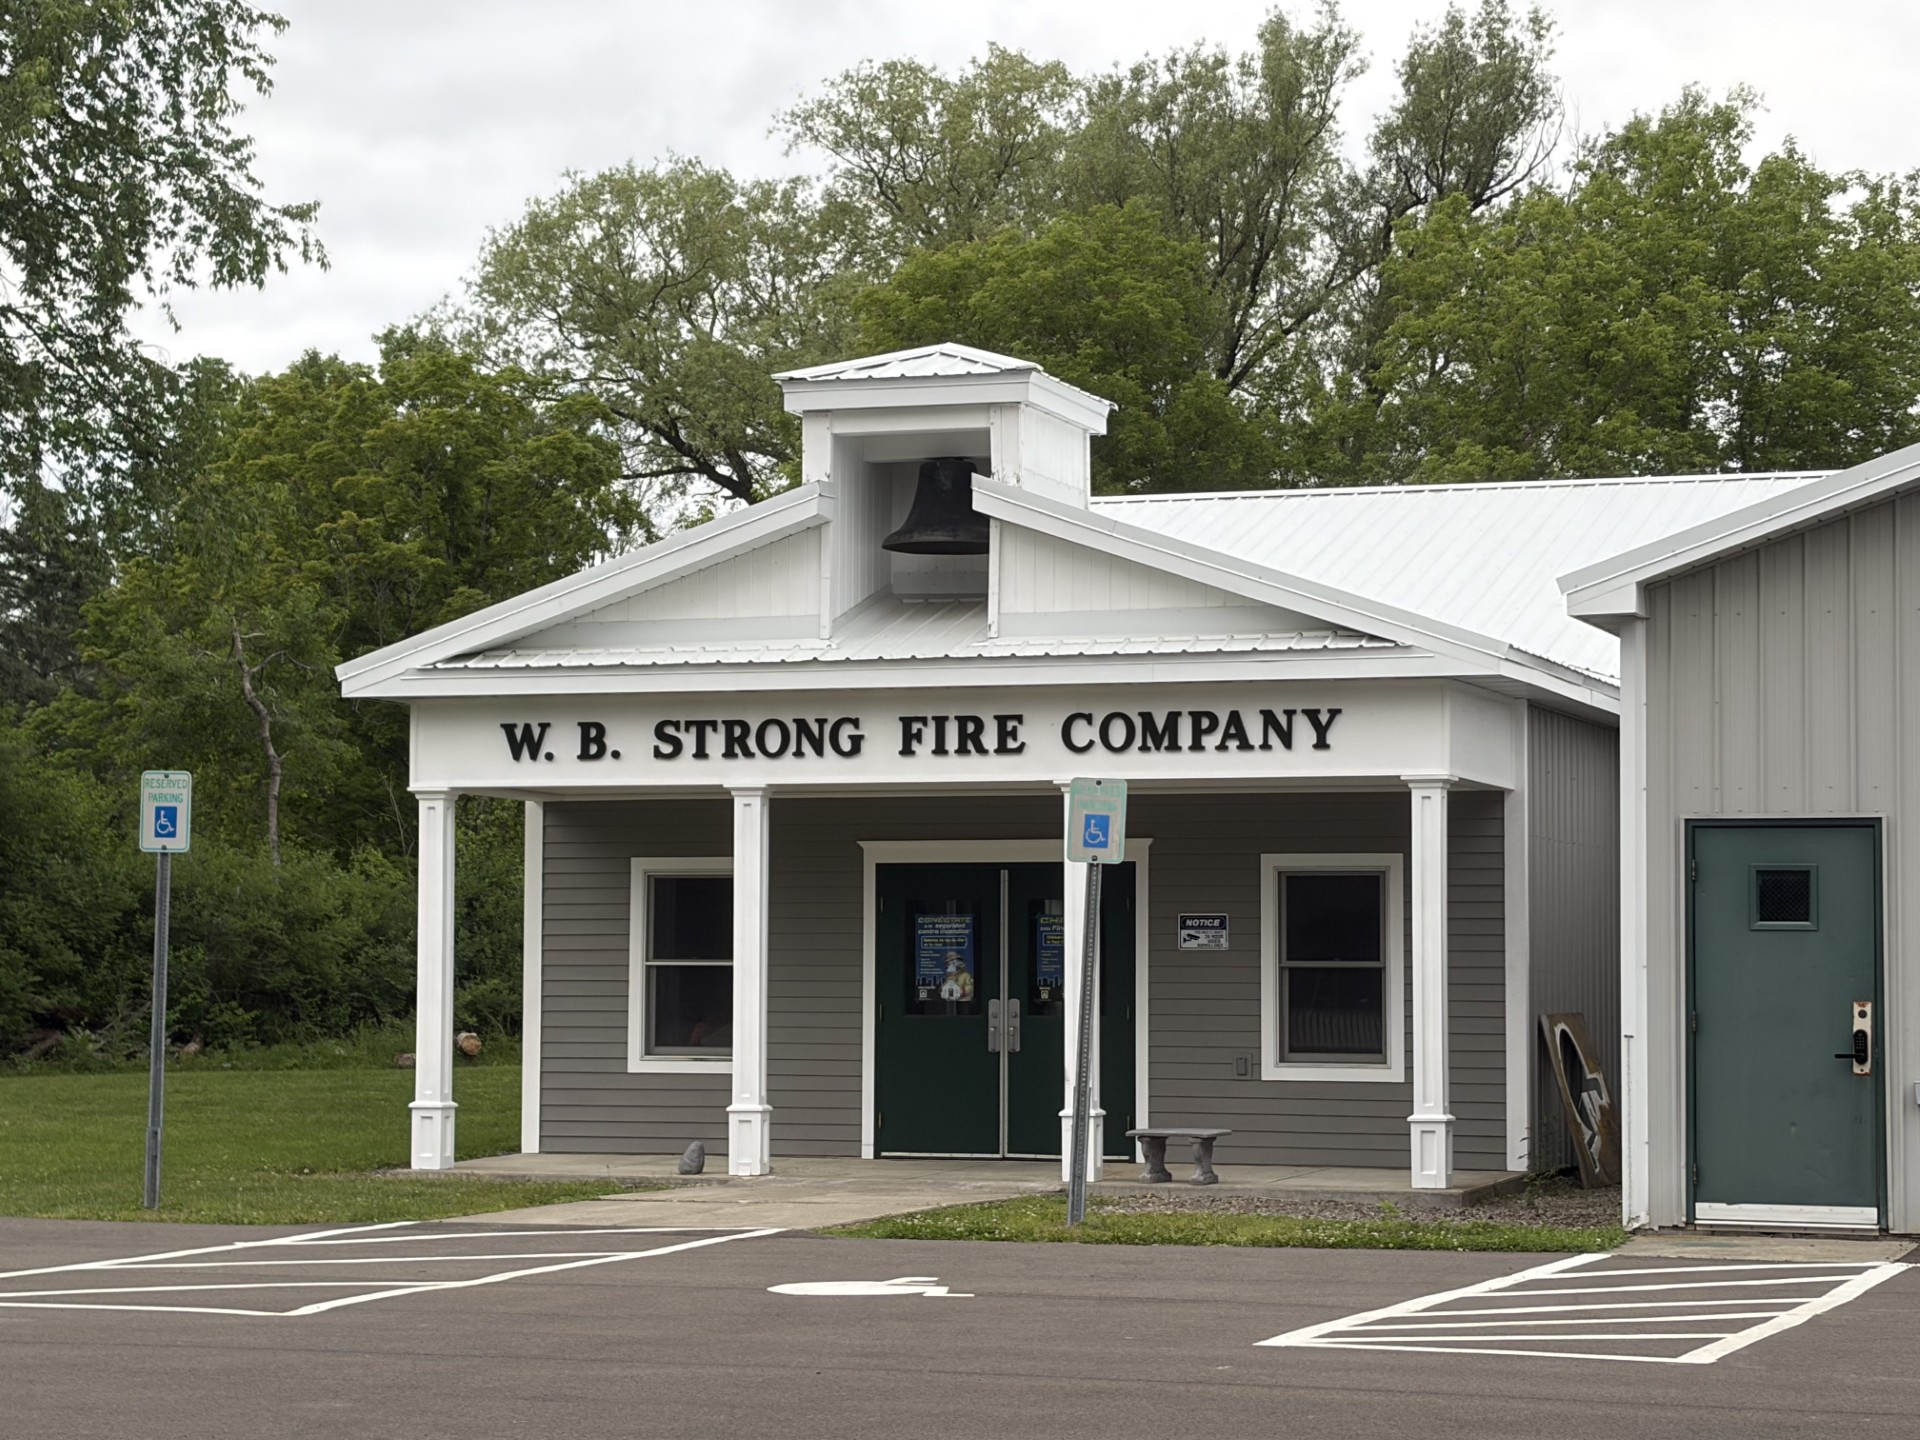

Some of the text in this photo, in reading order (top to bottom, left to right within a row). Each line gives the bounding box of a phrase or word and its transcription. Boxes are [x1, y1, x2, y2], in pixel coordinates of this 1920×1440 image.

[499, 707, 1343, 763] W. B. STRONG FIRE COMPANY
[144, 778, 188, 789] RESERVED
[148, 792, 184, 804] PARKING
[1185, 918, 1221, 927] NOTICE
